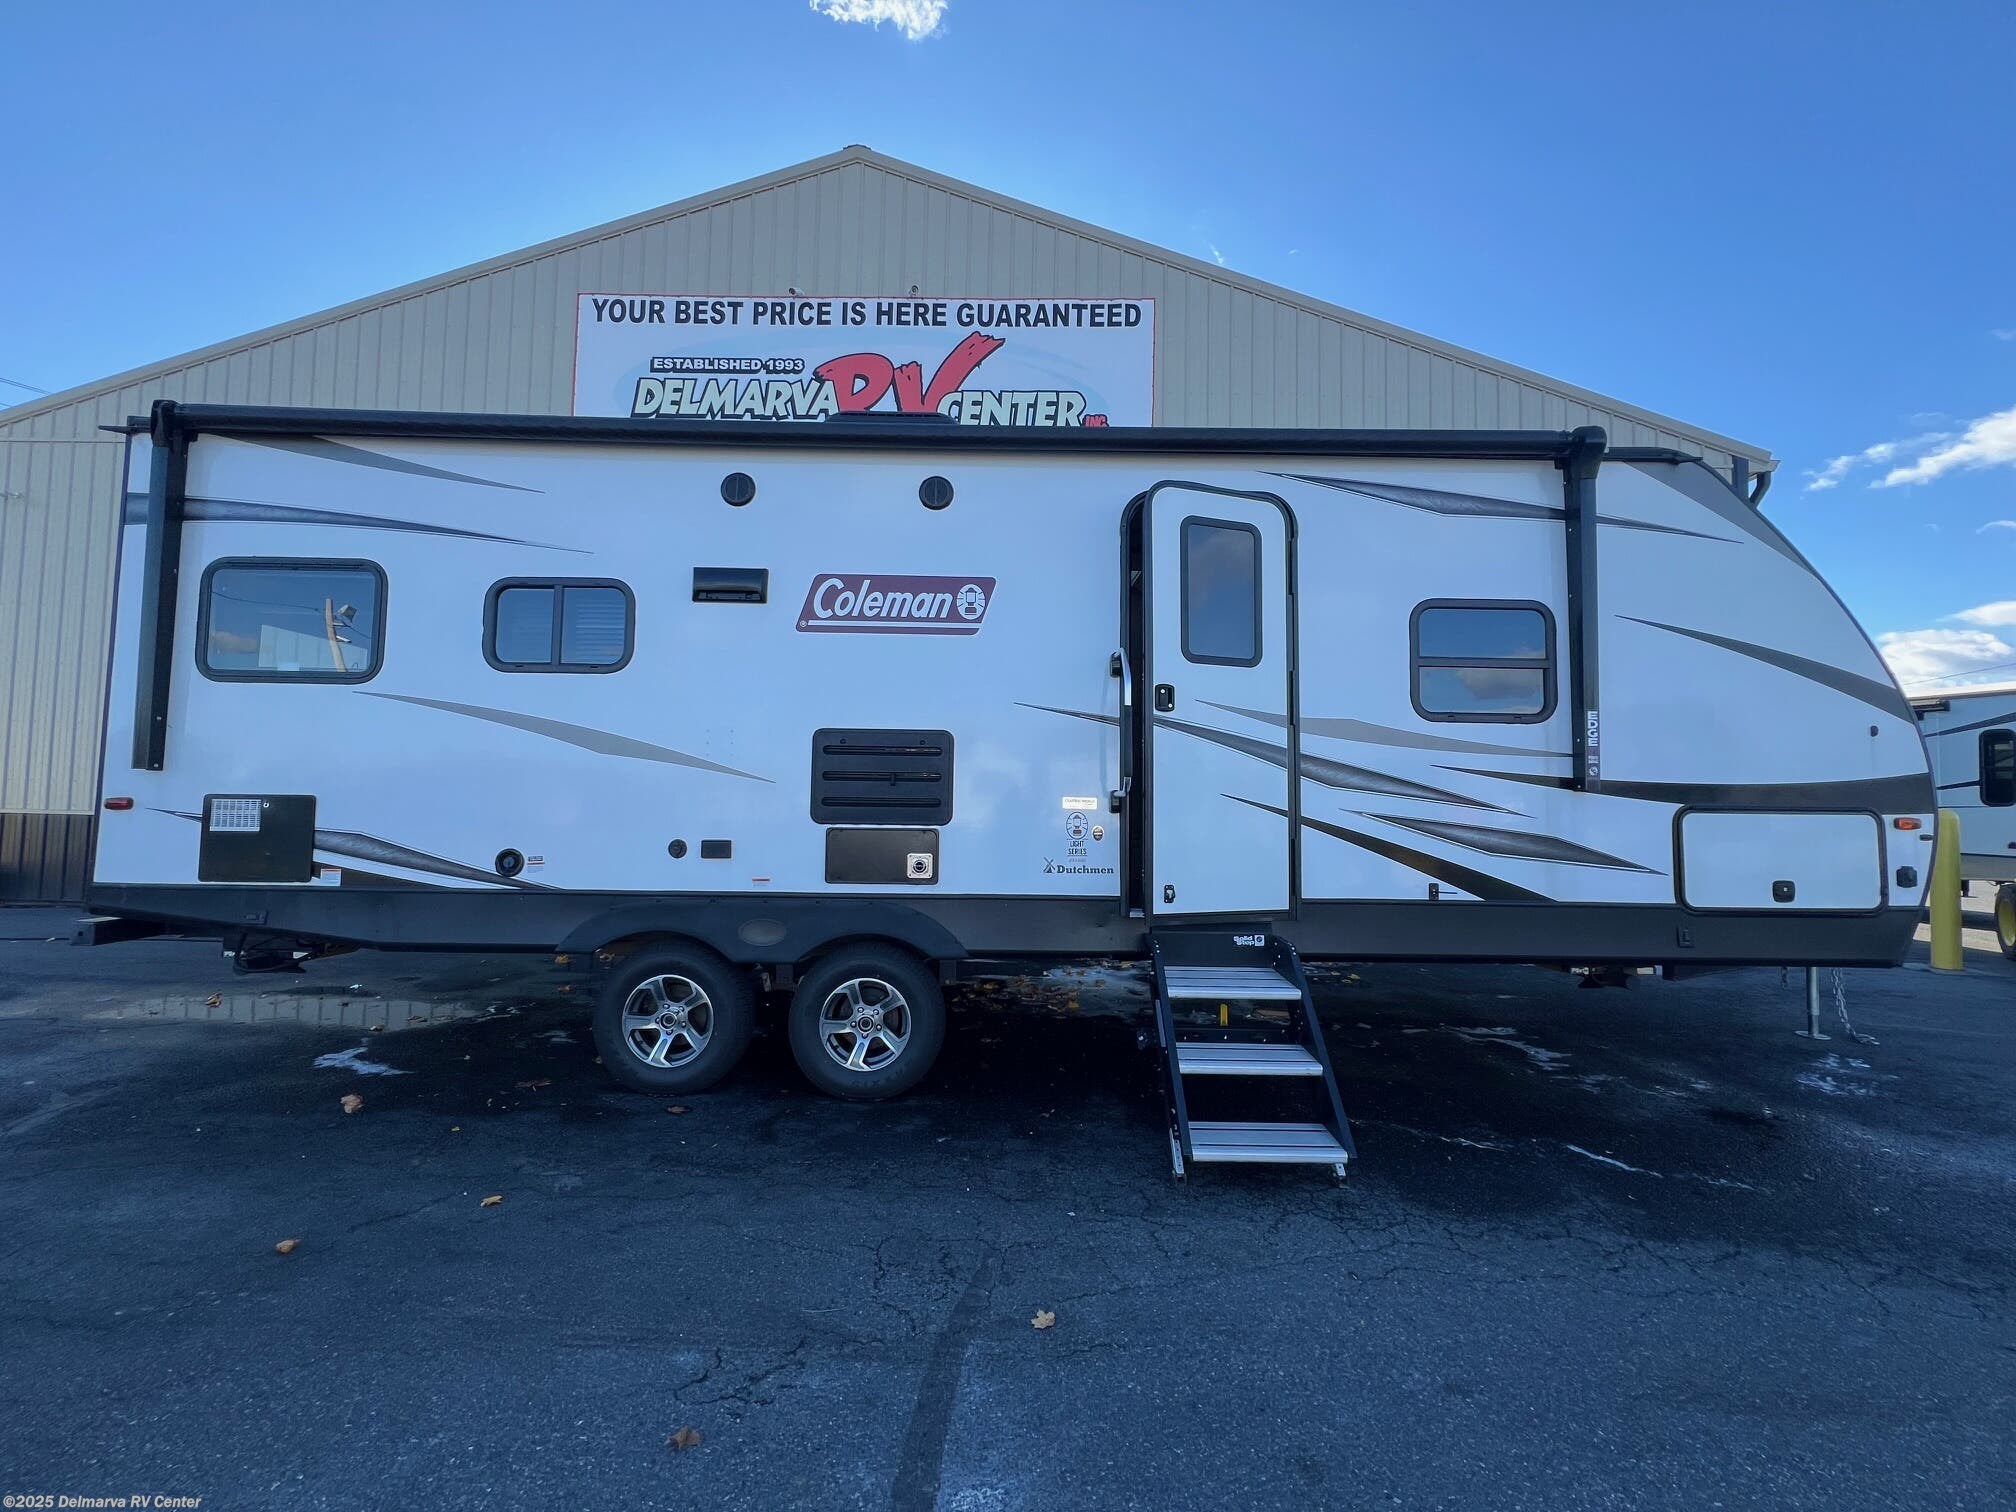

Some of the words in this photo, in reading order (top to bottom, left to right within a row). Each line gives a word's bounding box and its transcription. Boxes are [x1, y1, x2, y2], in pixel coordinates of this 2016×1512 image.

[592, 298, 665, 324] YOUR
[674, 300, 744, 325] BEST
[752, 301, 832, 326] PRICE
[842, 301, 867, 326] IS
[876, 302, 947, 327] HERE
[957, 303, 1142, 328] GUARANTEED
[652, 357, 763, 371] ESTABLISHED
[765, 358, 804, 371] 1993
[631, 377, 840, 419] DELMARVA
[937, 390, 1087, 426] CENTER
[813, 577, 953, 619] Coleman
[1587, 710, 1599, 747] EDGE
[1056, 864, 1114, 874] Dutchmen
